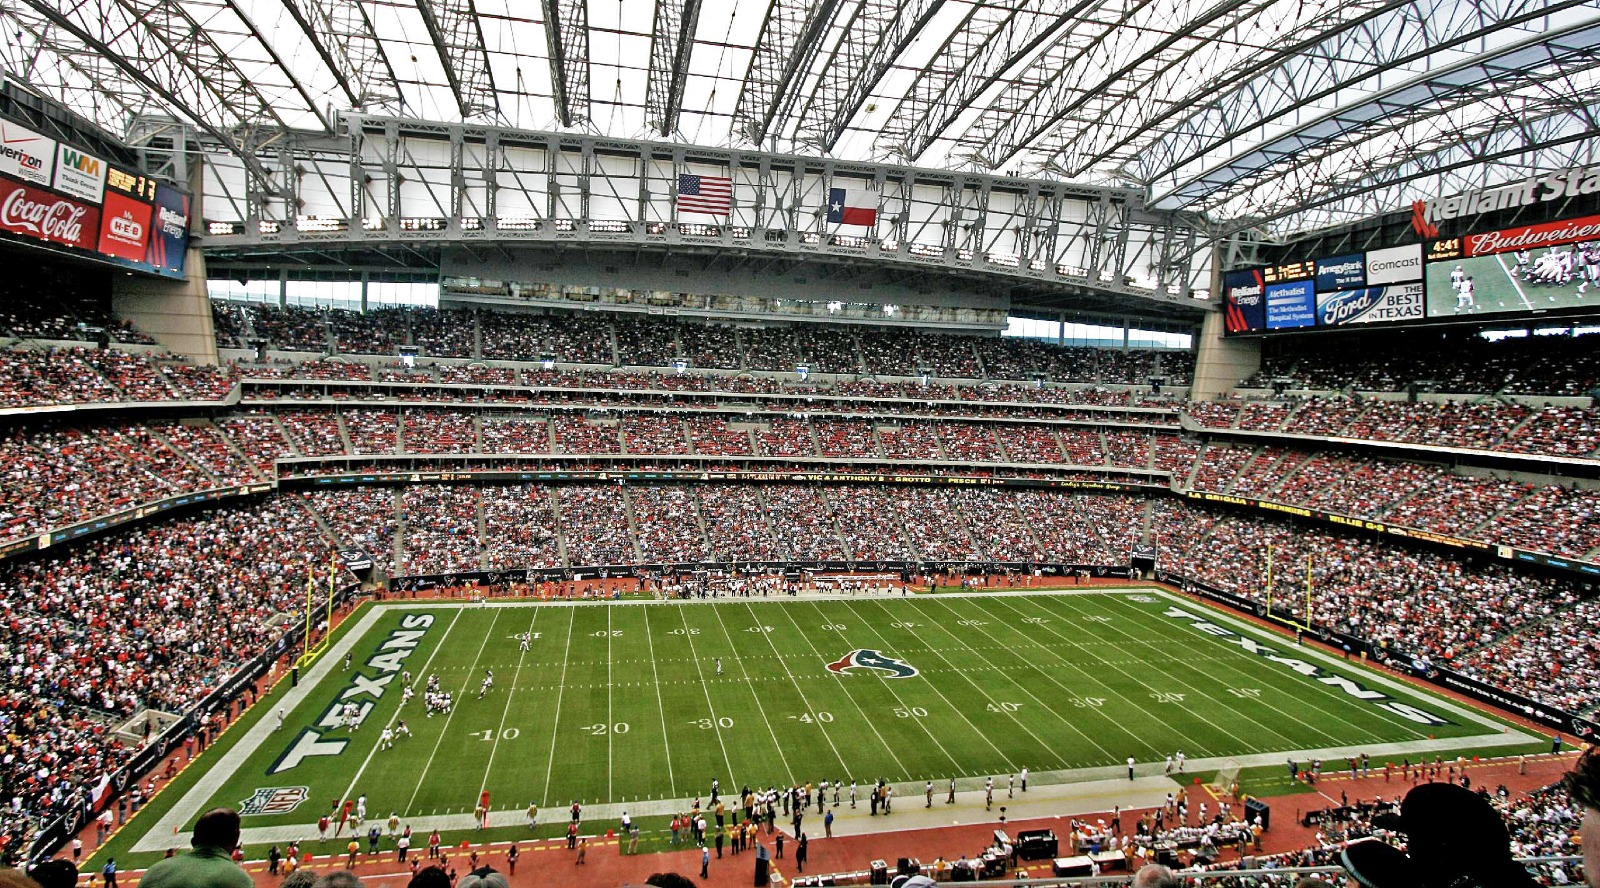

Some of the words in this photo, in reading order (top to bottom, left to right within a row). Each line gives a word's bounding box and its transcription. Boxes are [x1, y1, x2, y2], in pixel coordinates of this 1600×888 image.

[0, 144, 42, 170] verizon
[63, 147, 99, 177] WM
[18, 167, 48, 183] wireless
[1424, 177, 1538, 225] Reliant
[1, 188, 87, 242] Coca-Cola
[159, 206, 187, 228] Reliant
[1471, 222, 1600, 254] Budweiser
[1433, 238, 1459, 252] 4:41
[1231, 284, 1261, 298] Reliant
[1269, 287, 1305, 298] Methodist
[1404, 285, 1423, 293] THE
[1324, 288, 1372, 324] Ford
[1387, 293, 1423, 306] BEST
[1279, 305, 1307, 313] Methodist
[1377, 305, 1422, 318] TEXAS
[1269, 314, 1292, 322] Hospital
[1292, 313, 1314, 321] System
[1188, 491, 1201, 499] LA
[1205, 493, 1247, 505] GRIGLIA
[1329, 514, 1363, 527] WILLIE
[1163, 606, 1452, 726] TEXANS
[266, 613, 436, 776] TEXANS
[1149, 692, 1184, 703] 20
[986, 702, 1018, 713] 40
[1069, 697, 1104, 708] 30
[799, 711, 834, 724] 40
[893, 707, 928, 718] 50
[591, 722, 629, 735] 20
[698, 717, 734, 730] 30
[479, 728, 520, 741] 10
[263, 789, 302, 811] NFL
